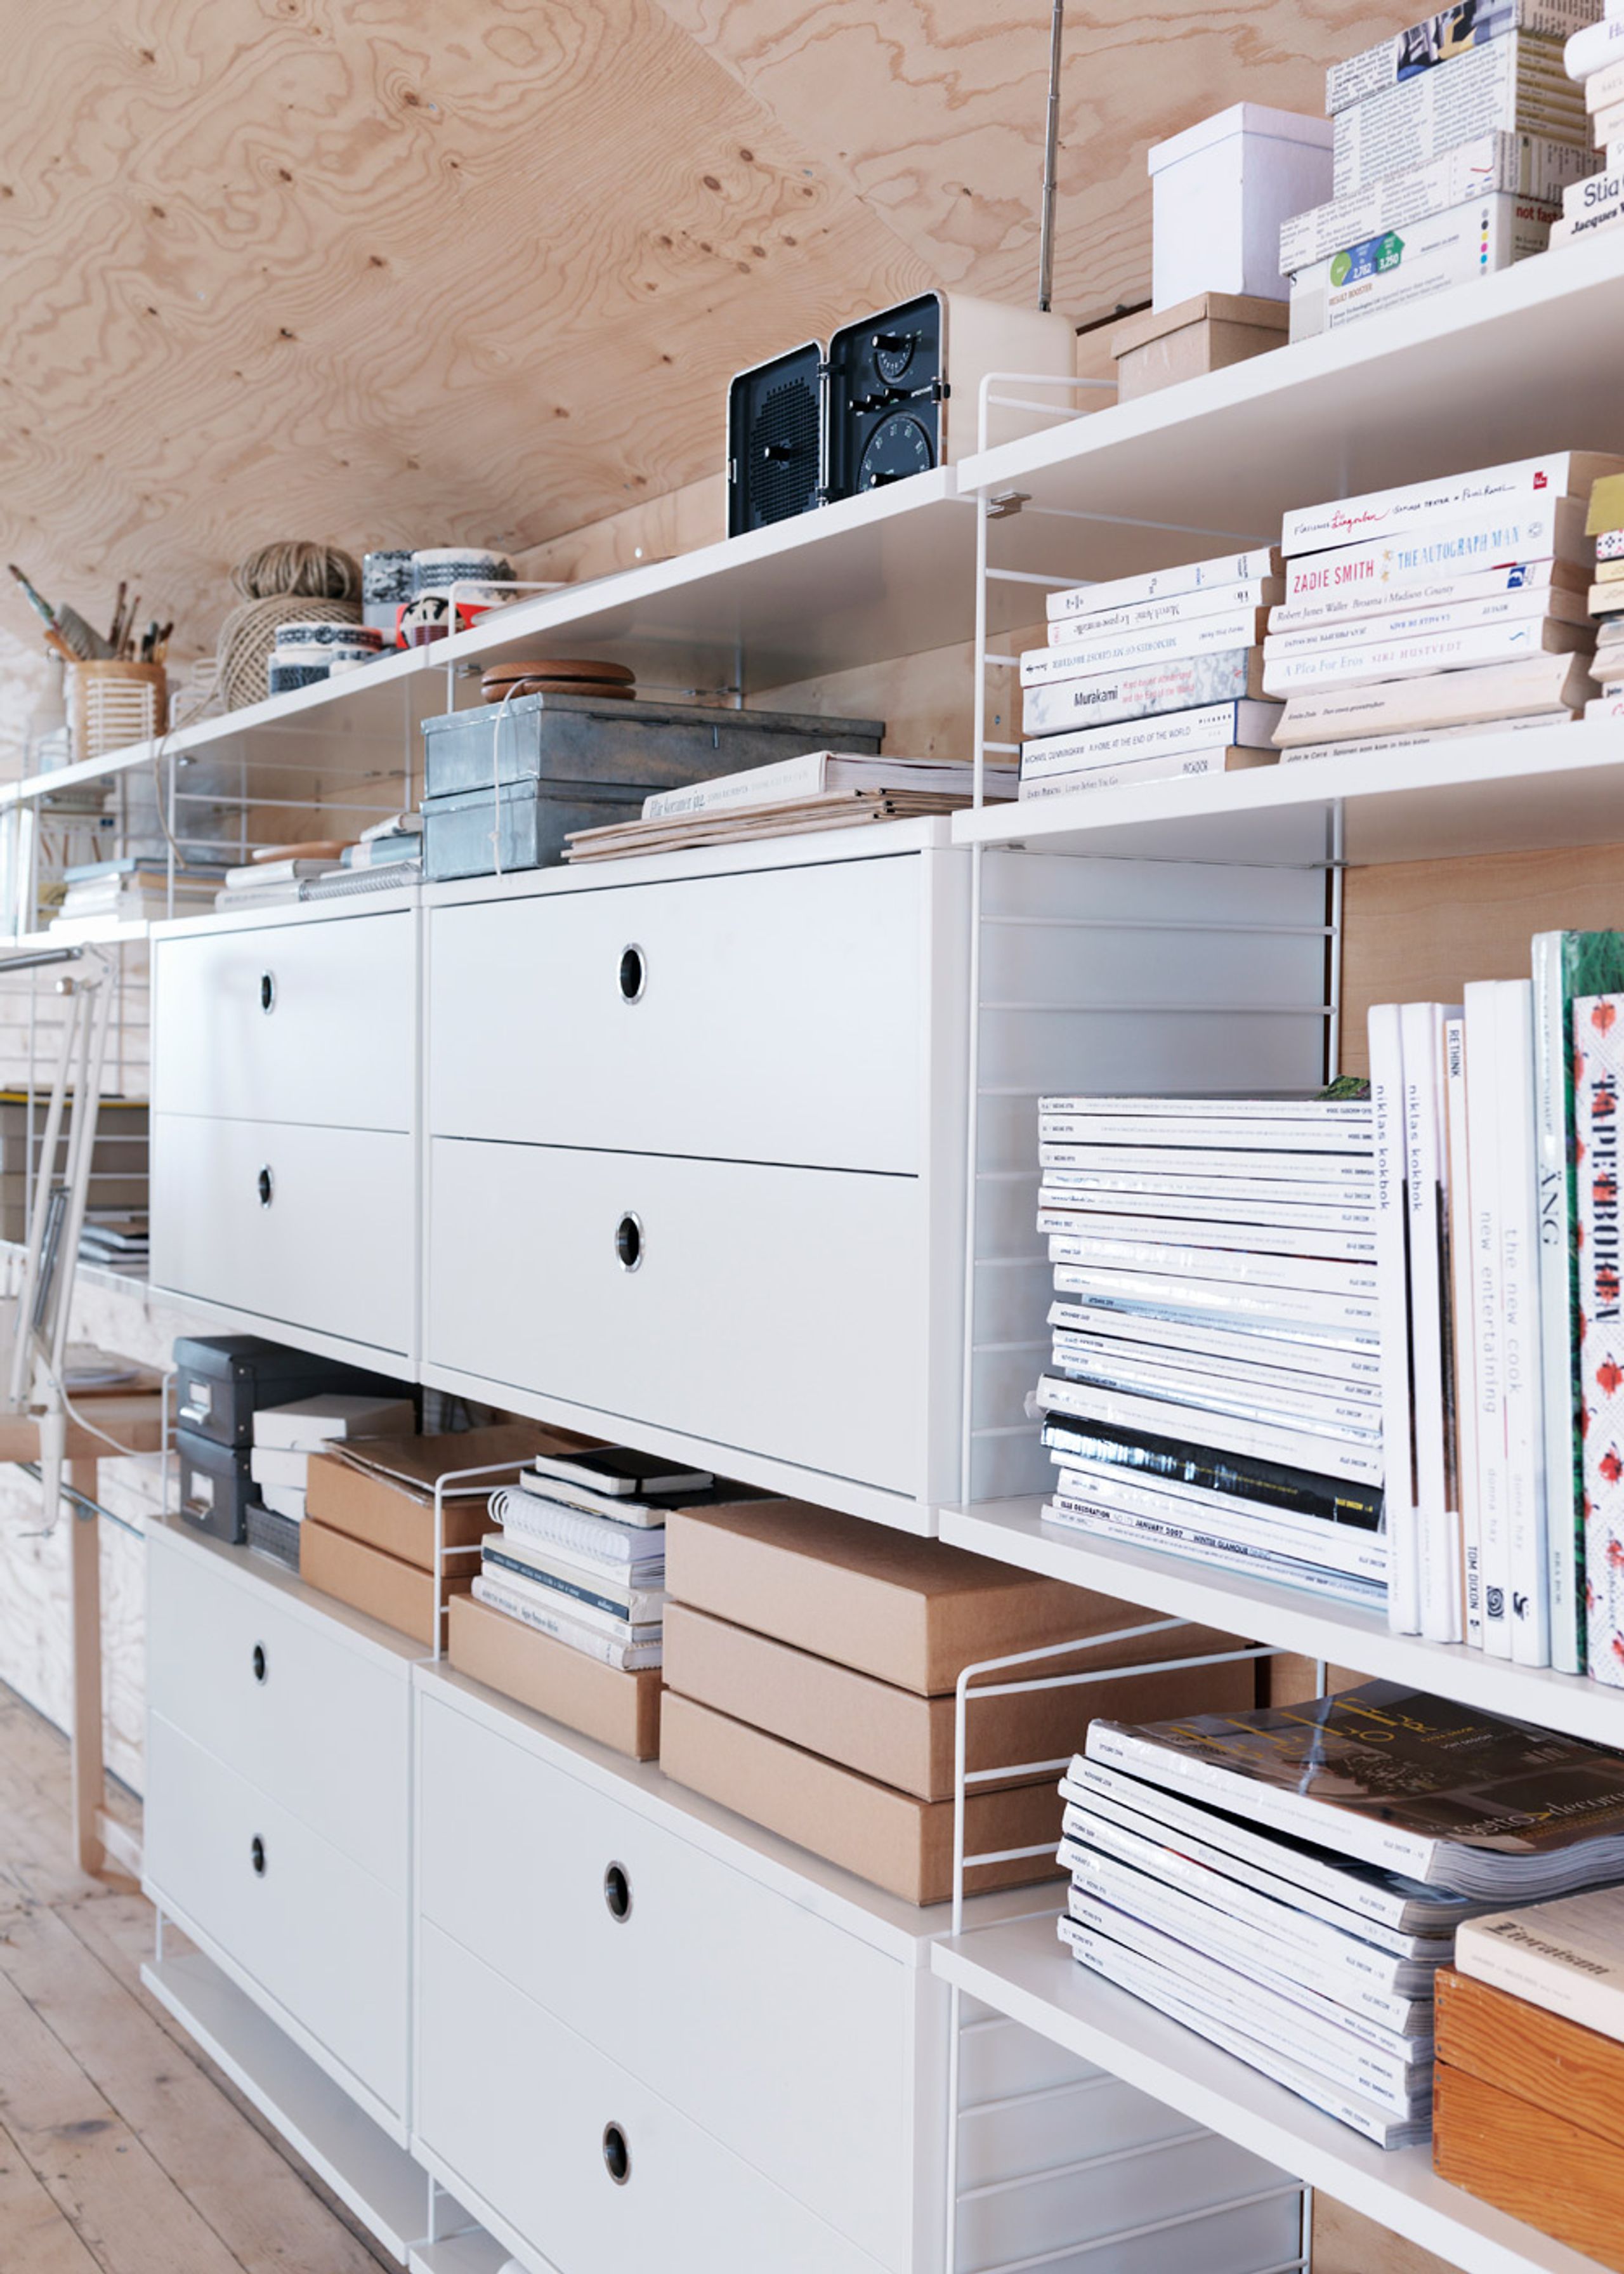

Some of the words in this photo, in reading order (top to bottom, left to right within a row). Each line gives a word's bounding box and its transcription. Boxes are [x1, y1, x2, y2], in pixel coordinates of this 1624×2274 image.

[1516, 206, 1535, 221] not
[1293, 569, 1330, 595] ZADIE
[1333, 560, 1375, 586] SMITH
[1398, 551, 1418, 570] THE
[1421, 531, 1489, 566] AUTOGRAPH
[1490, 526, 1520, 550] MAN
[1276, 609, 1302, 622] Robert
[1388, 589, 1423, 605] Madison
[1284, 664, 1292, 677] A
[1293, 660, 1318, 676] Plea
[1320, 656, 1339, 672] For
[1339, 654, 1364, 669] Eros
[1398, 641, 1462, 657] HUSTVEDT
[1073, 685, 1118, 707] Murakami
[1132, 734, 1146, 745] END
[1156, 730, 1167, 741] THE
[1168, 725, 1192, 739] WORLD
[1448, 1029, 1460, 1079] RETHINK
[1375, 1084, 1388, 1141] niklas
[1408, 1084, 1420, 1142] niklas
[1378, 1147, 1391, 1211] kokbok
[1410, 1147, 1423, 1213] kokbok
[1590, 1074, 1620, 1325] TAPETBOKEN
[1540, 1162, 1562, 1247] ÄNG
[1479, 1211, 1492, 1251] new
[1504, 1228, 1519, 1270] the
[1505, 1282, 1519, 1325] new
[1481, 1266, 1500, 1416] entertaining
[1506, 1338, 1522, 1396] cook
[1134, 1520, 1163, 1535] JANUARY
[1165, 1525, 1184, 1539] 2007
[1217, 1541, 1249, 1556] GLAMOUR
[1467, 1546, 1478, 1570] TOM
[1468, 1573, 1479, 1610] DIXON
